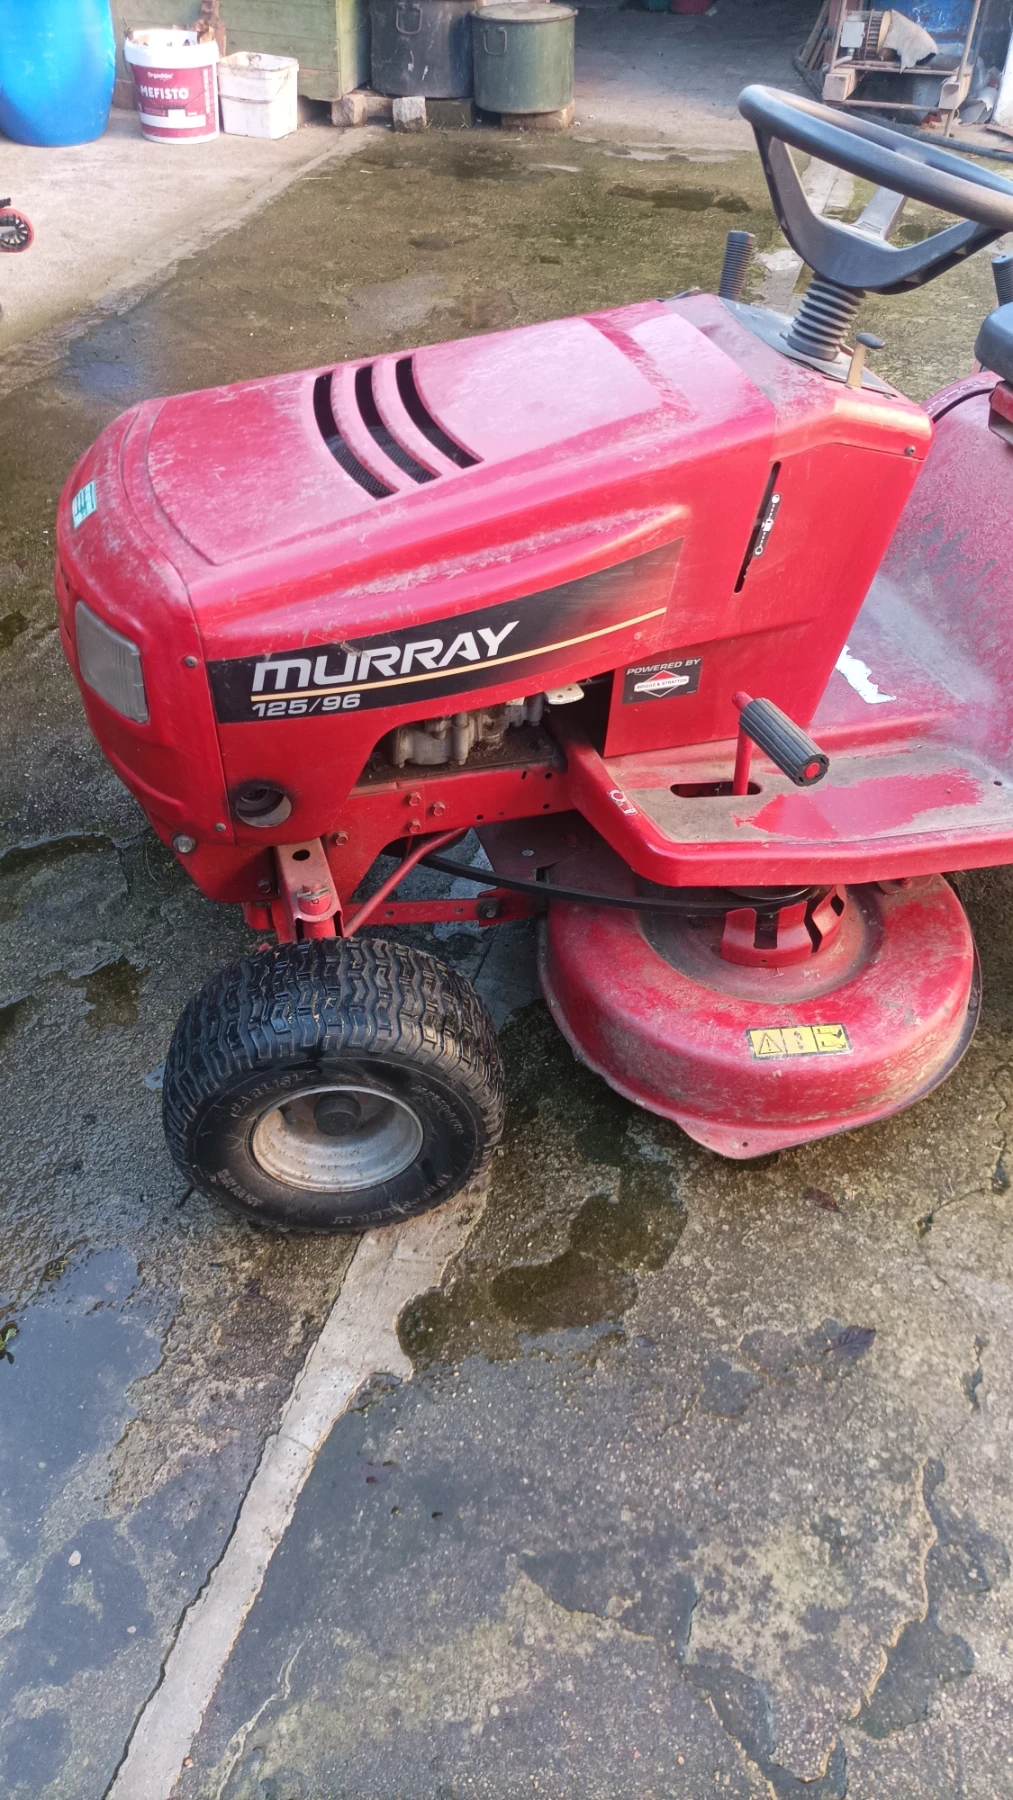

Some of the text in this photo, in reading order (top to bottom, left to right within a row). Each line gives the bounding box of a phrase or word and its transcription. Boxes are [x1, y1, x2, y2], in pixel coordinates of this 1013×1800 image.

[140, 86, 189, 100] MEFISTO
[251, 620, 519, 692] MURRAY
[627, 658, 701, 675] POWERED BY
[251, 693, 361, 717] 125/96
